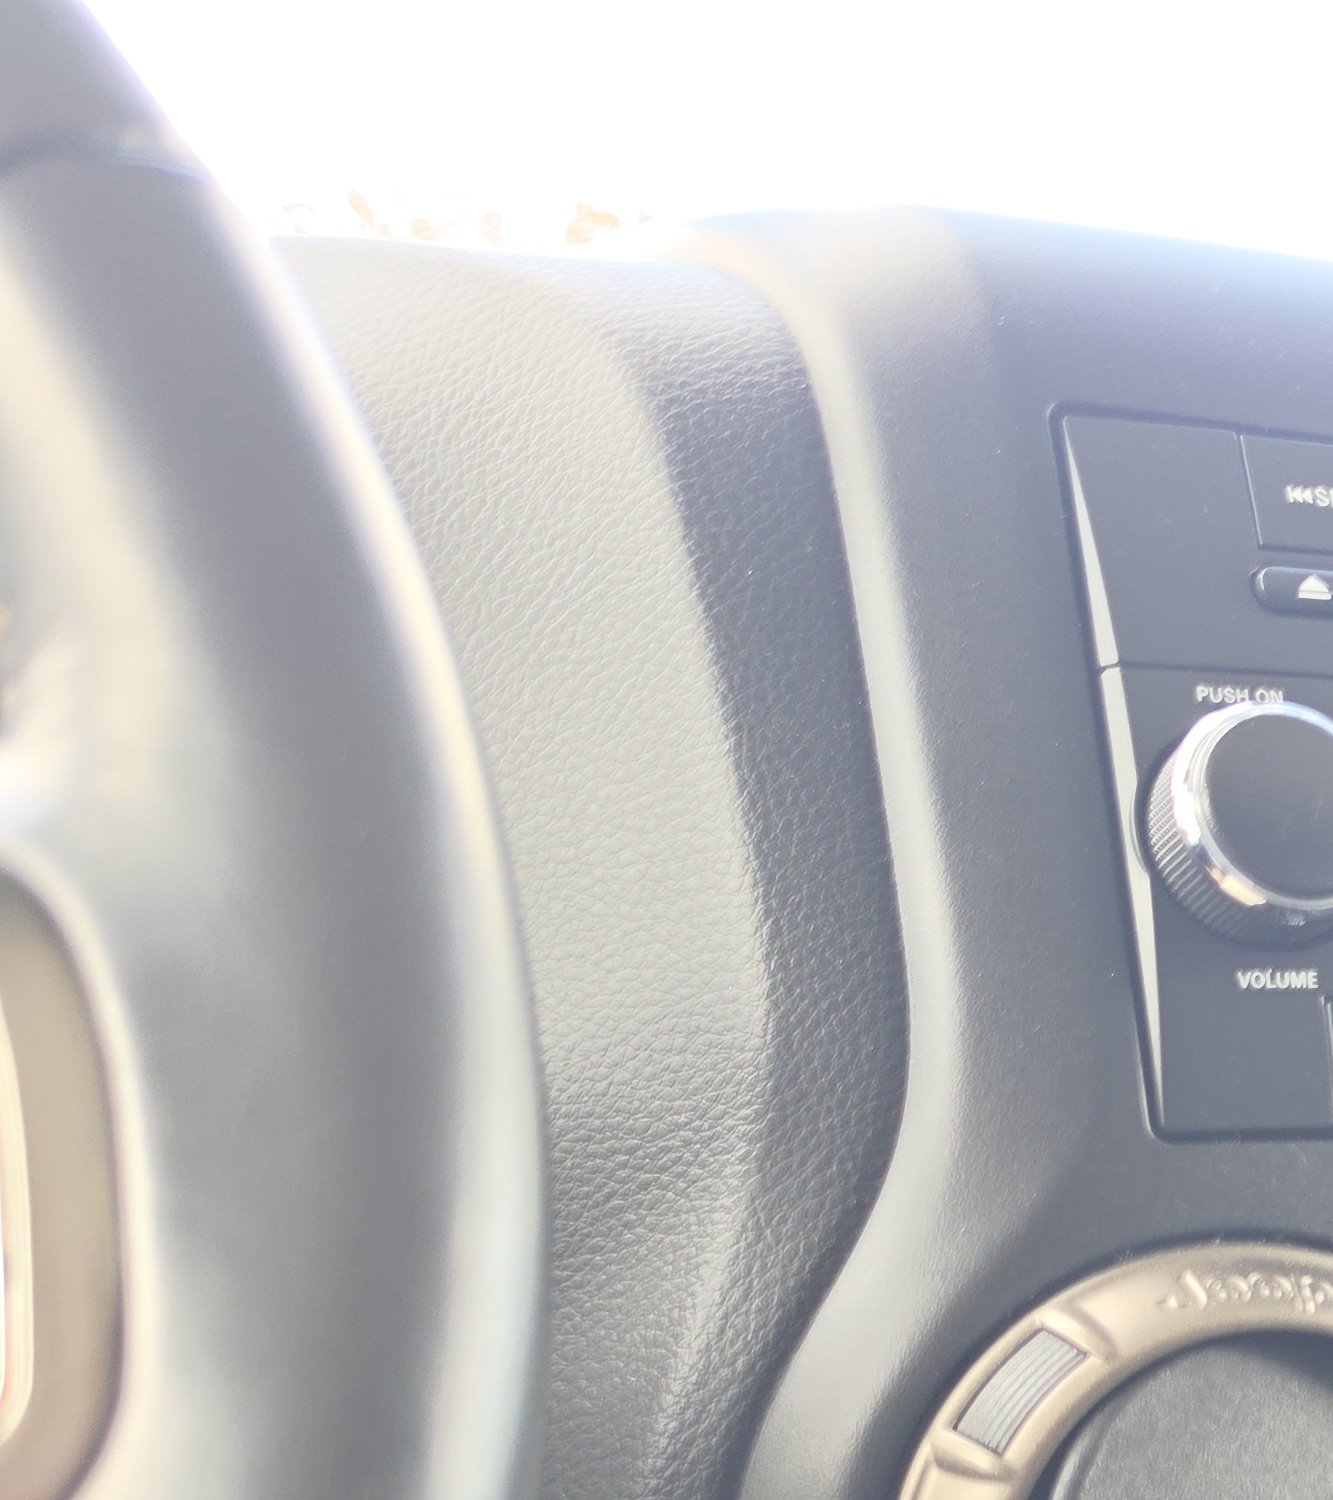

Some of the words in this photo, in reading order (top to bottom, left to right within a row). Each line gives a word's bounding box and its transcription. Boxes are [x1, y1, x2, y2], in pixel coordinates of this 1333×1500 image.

[1196, 684, 1249, 703] PUSH
[1255, 688, 1284, 703] ON
[1236, 968, 1319, 990] VOLUME
